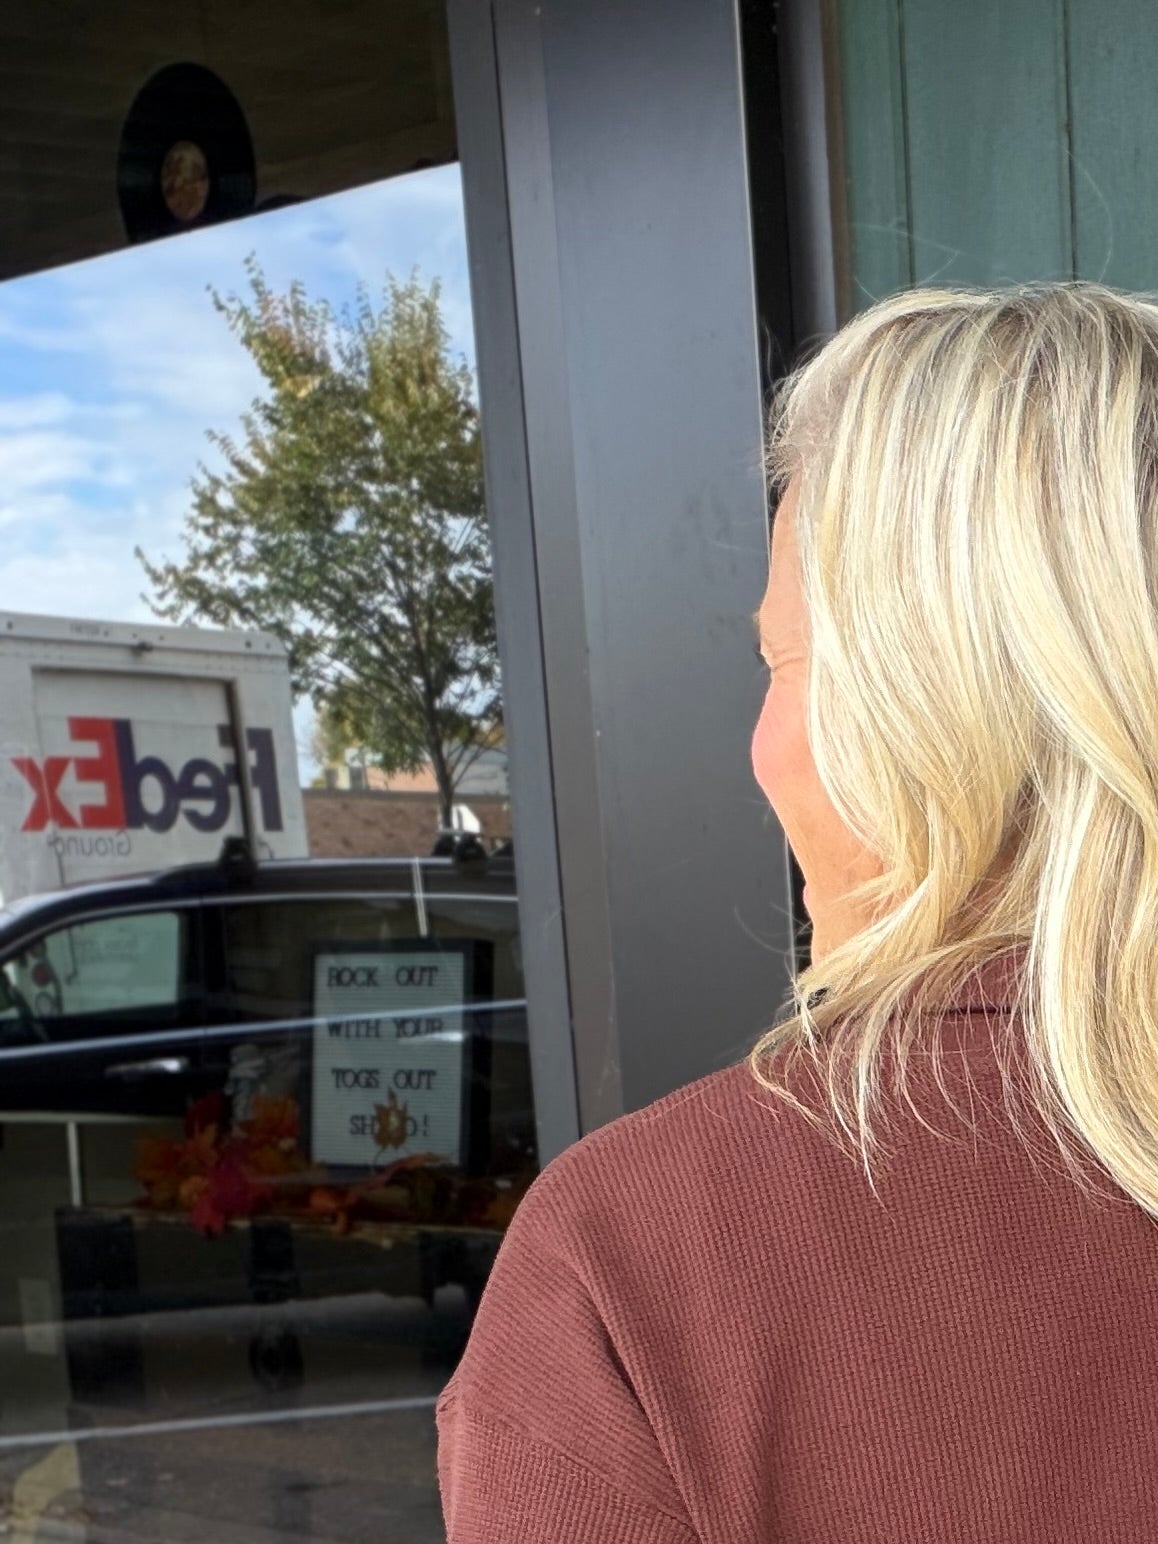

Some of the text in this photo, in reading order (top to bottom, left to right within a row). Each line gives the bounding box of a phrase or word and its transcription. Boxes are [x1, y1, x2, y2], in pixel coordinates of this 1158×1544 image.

[327, 966, 438, 987] ROCK OUT
[327, 1017, 443, 1039] WITH YOUR
[331, 1068, 436, 1090] TOGS OUT
